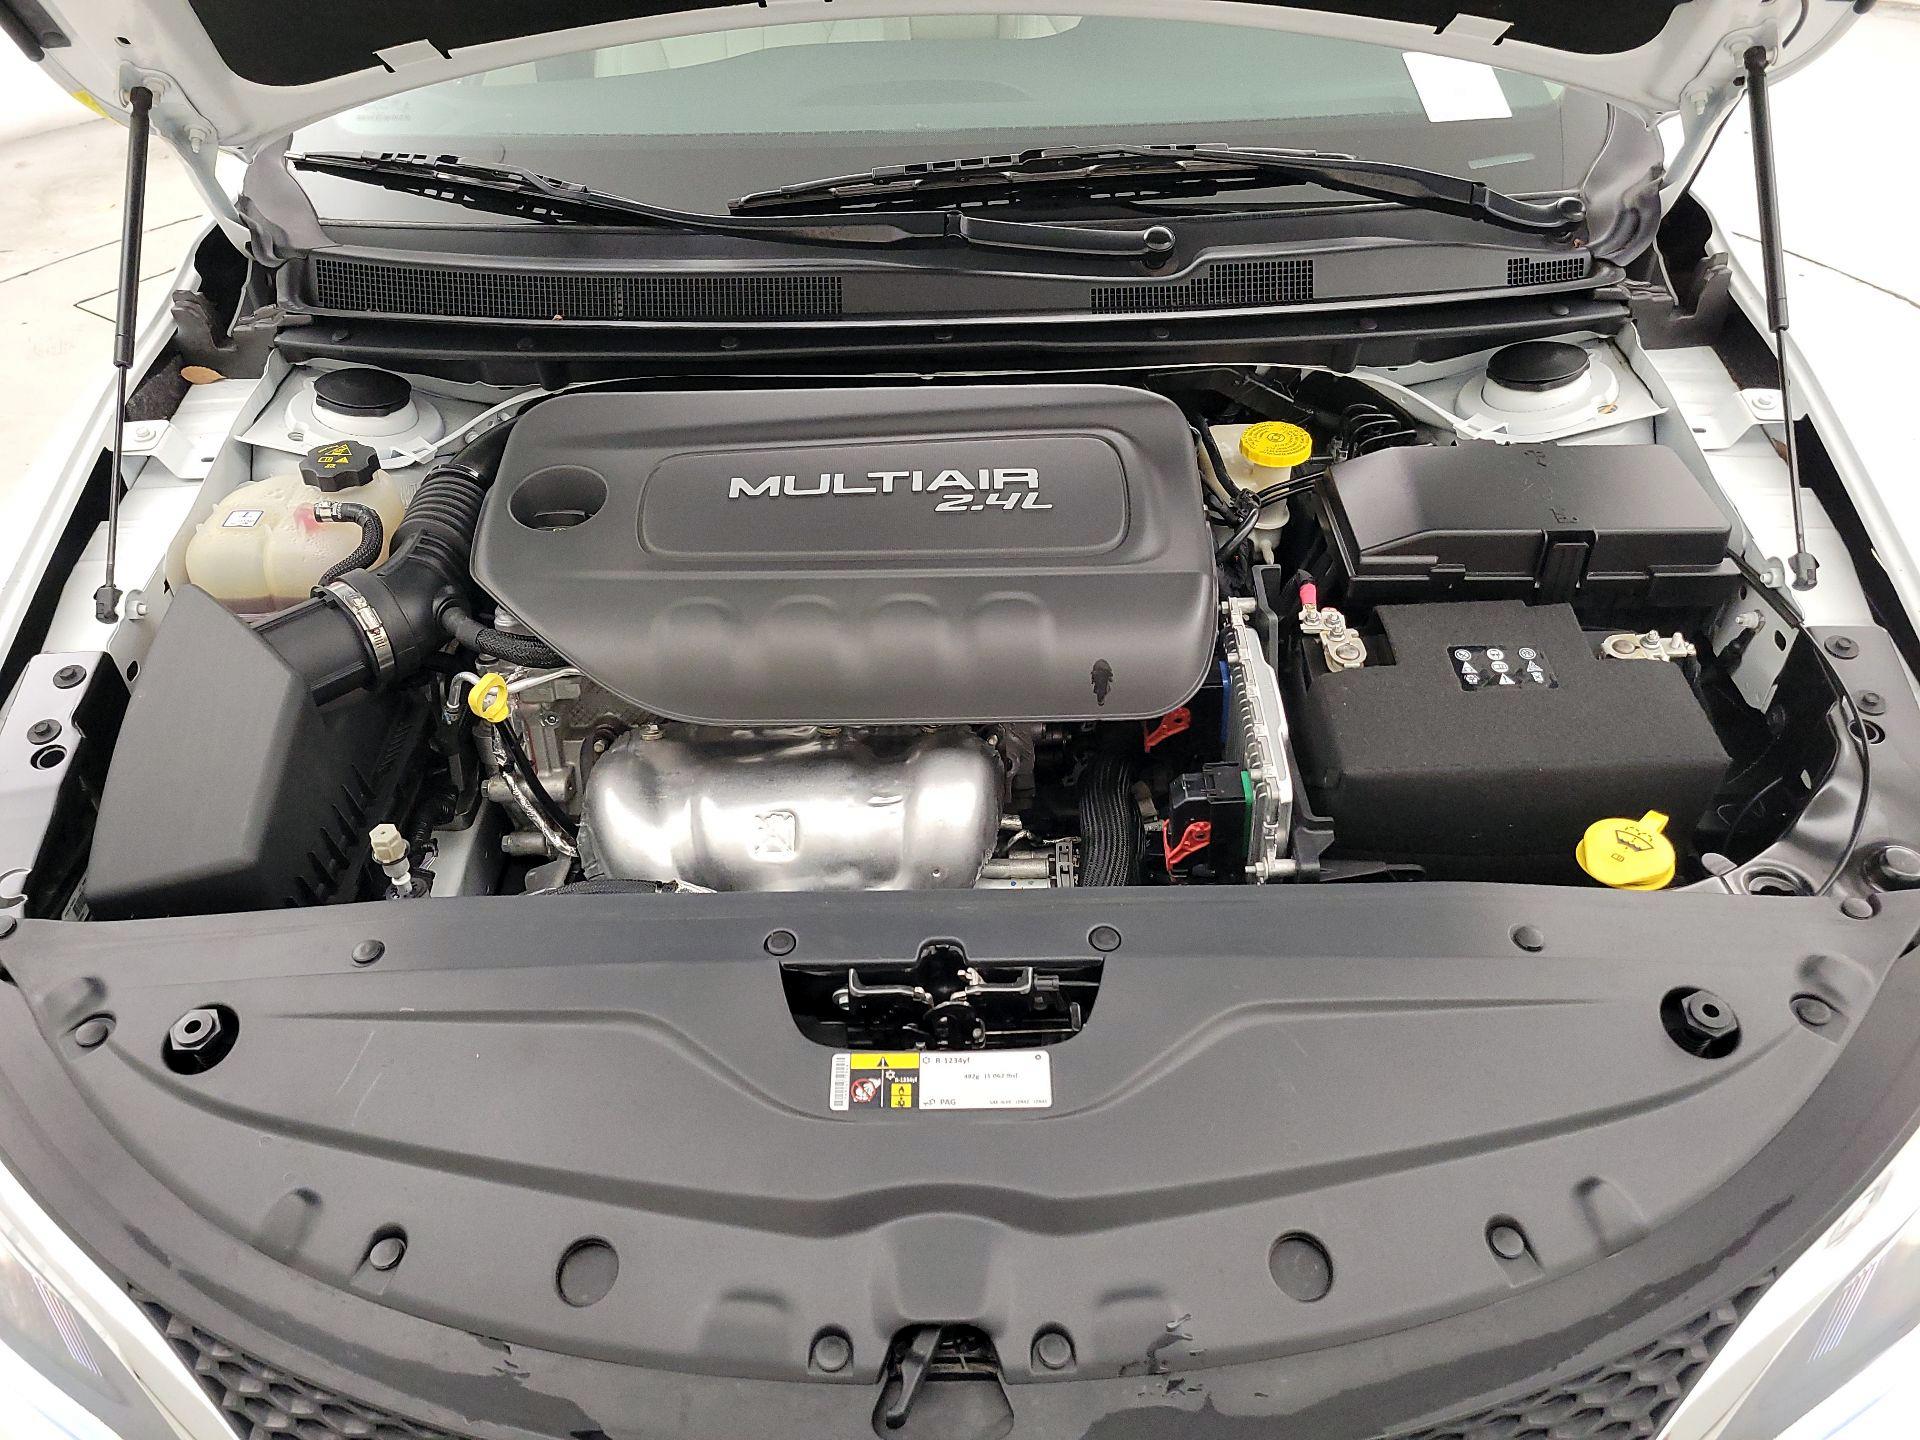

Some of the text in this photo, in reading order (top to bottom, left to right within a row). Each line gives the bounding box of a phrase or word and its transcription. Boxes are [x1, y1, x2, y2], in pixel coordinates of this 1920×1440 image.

[728, 468, 1039, 498] MULTIAIR
[934, 491, 1053, 512] 2.4L
[940, 1098, 956, 1106] PAG
